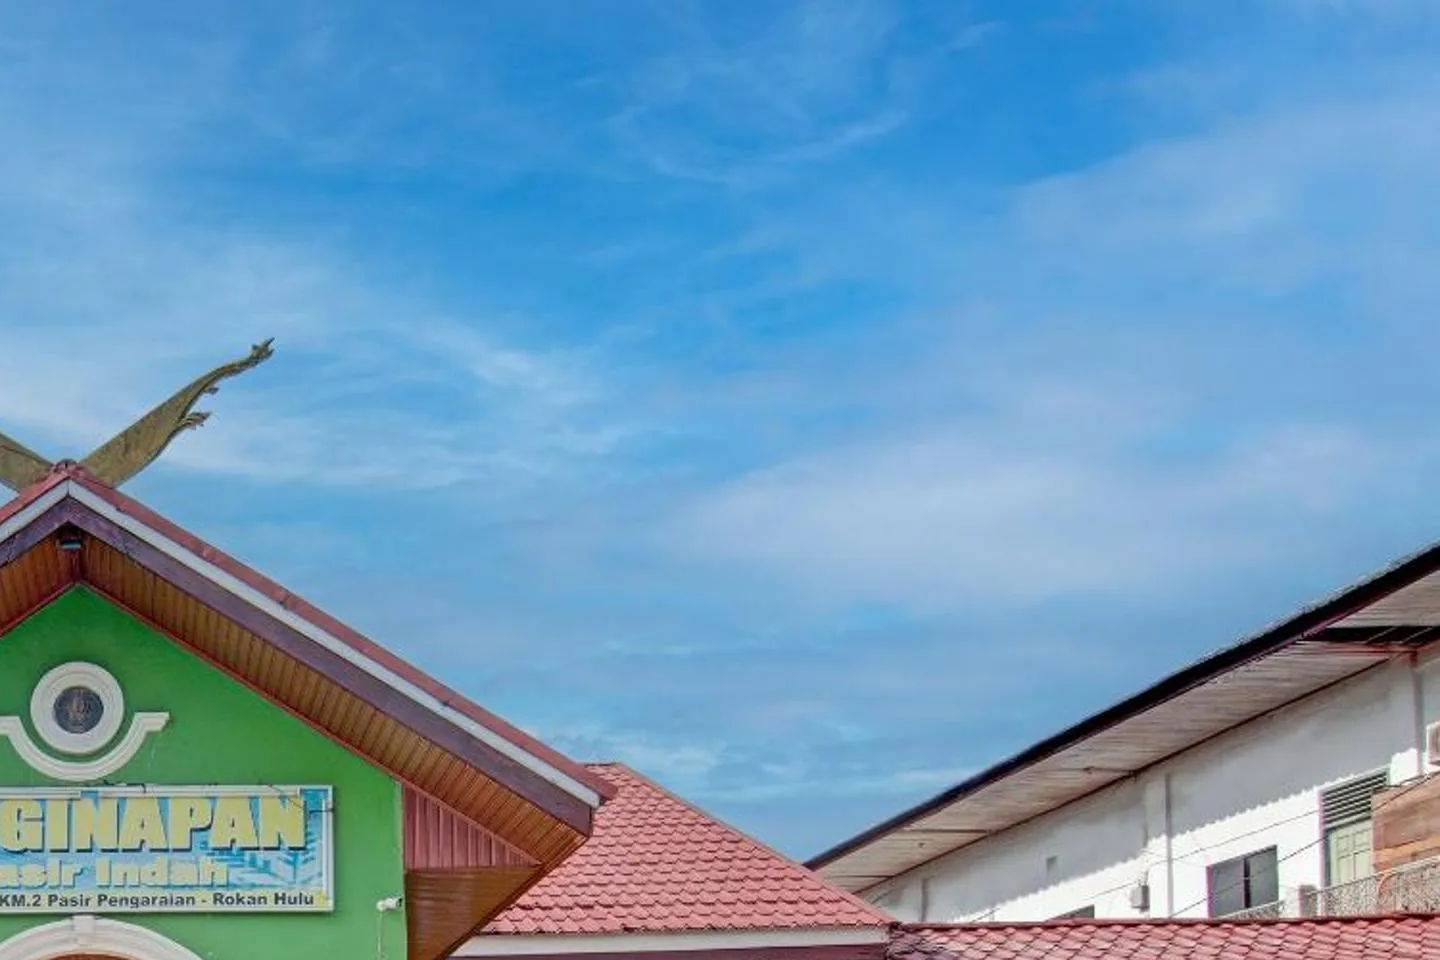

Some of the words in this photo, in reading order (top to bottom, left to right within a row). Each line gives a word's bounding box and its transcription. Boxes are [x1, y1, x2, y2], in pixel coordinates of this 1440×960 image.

[95, 855, 229, 887] Indah
[48, 893, 91, 907] Pasir
[97, 892, 196, 909] Pengaraian
[213, 892, 268, 906] Rokan
[273, 891, 314, 906] Hulu
